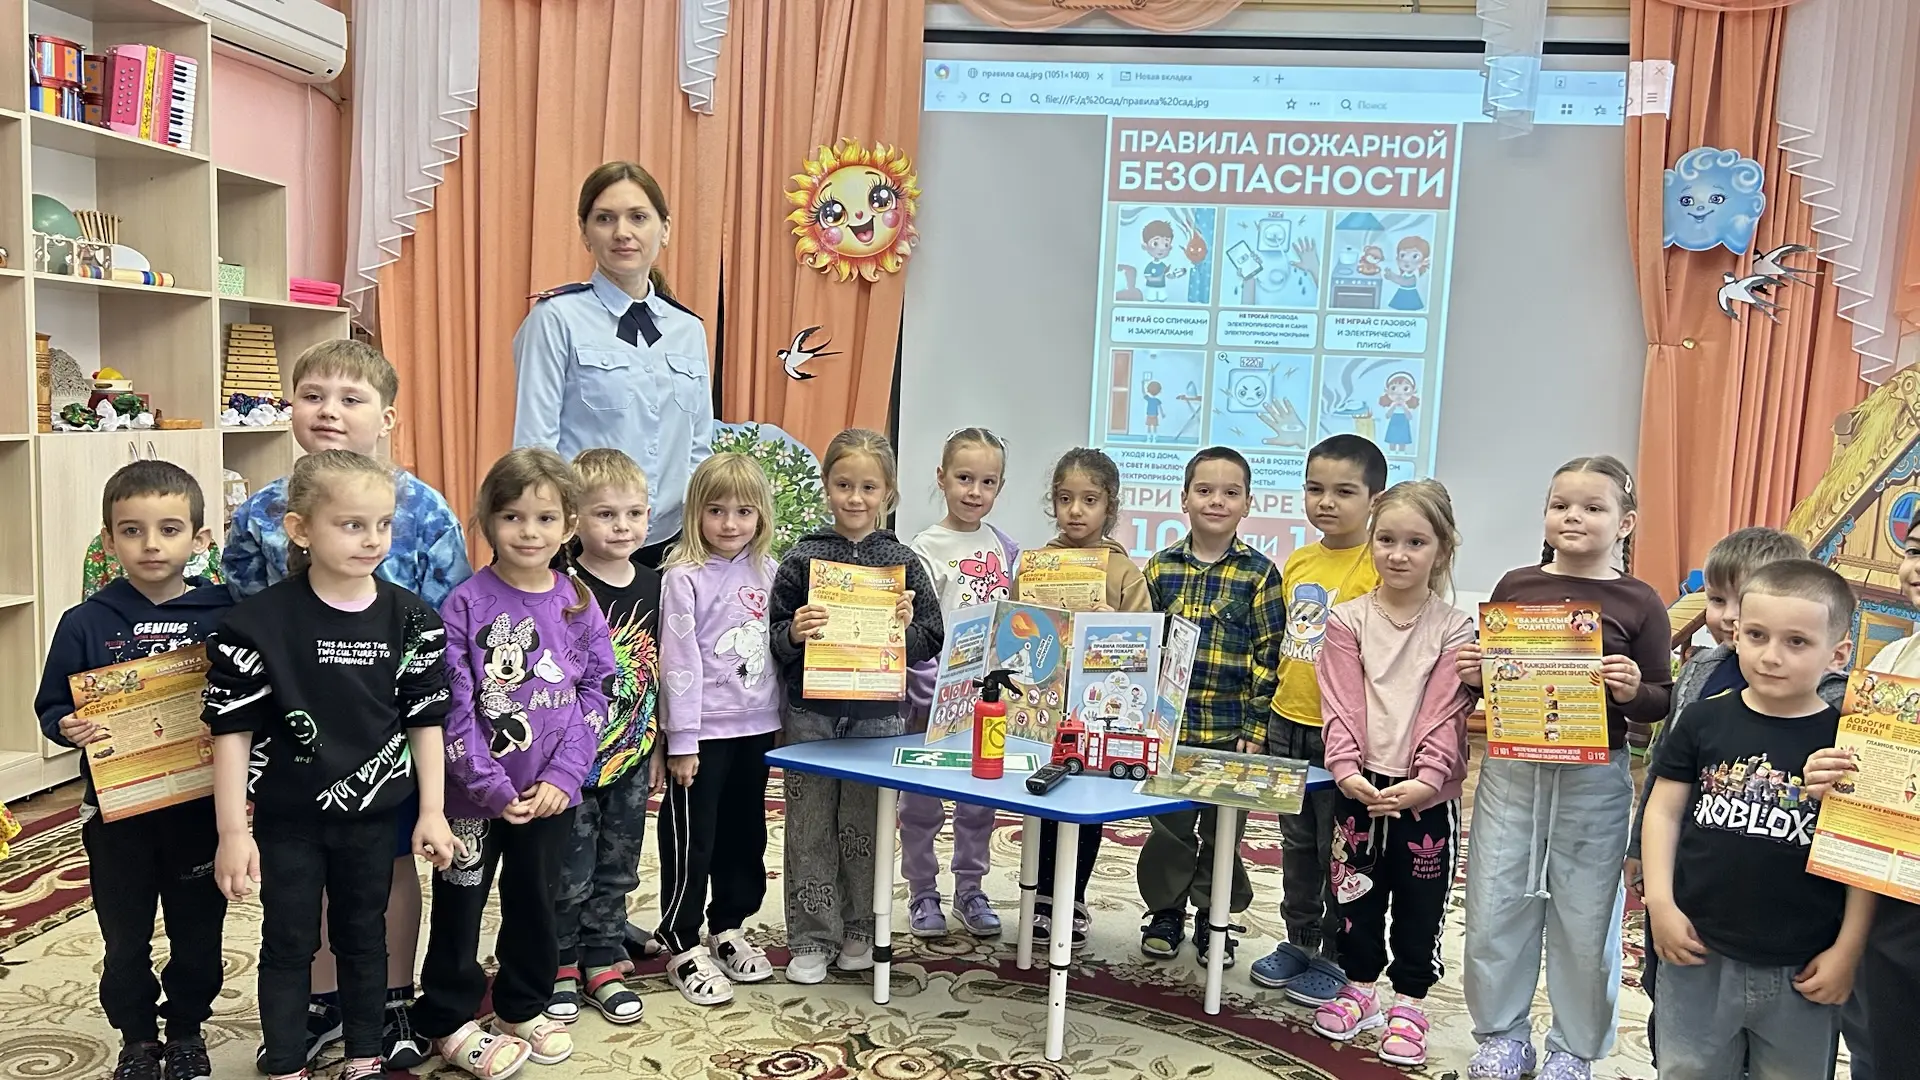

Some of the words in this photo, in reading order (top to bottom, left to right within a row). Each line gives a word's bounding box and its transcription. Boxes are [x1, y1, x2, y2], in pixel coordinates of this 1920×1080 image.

[1357, 100, 1388, 110] Поиск
[1120, 129, 1259, 155] ПРАВИЛА
[1266, 129, 1448, 159] ПОЖАРНОЙ
[1119, 161, 1446, 198] БЕЗОПАСНОСТИ
[1126, 315, 1151, 323] ИГРАЙ
[1347, 317, 1371, 325] ИГРАЙ
[1380, 319, 1416, 327] ГАЗОВОЙ
[1345, 330, 1410, 338] ЭЛЕКТРИЧЕСКОЙ
[1120, 473, 1183, 481] ЛЕКТРОПРИБОРЫ
[1252, 468, 1302, 476] ОСТОРОННИЕ
[1121, 487, 1172, 507] ПРИ
[1251, 493, 1293, 513] АРЕ
[1129, 518, 1187, 558] 10
[1243, 534, 1279, 556] ЛИ
[133, 622, 188, 635] GENIUS
[317, 640, 336, 648] THIS
[337, 641, 372, 649] ALLOWS
[373, 642, 388, 650] THE
[336, 649, 377, 657] CULTURES
[156, 657, 202, 674] ПАМЯТКА
[319, 656, 374, 665] INTERMINGLE
[83, 699, 122, 712] ДОРОГИЕ
[84, 705, 118, 716] РЕБЯТА!
[1846, 723, 1882, 736] РЕБЯТА!
[1847, 717, 1891, 730] ДОРОГИЕ
[1594, 752, 1605, 760] 112
[1696, 794, 1816, 846] ROBLOX
[1346, 888, 1367, 901] adidas
